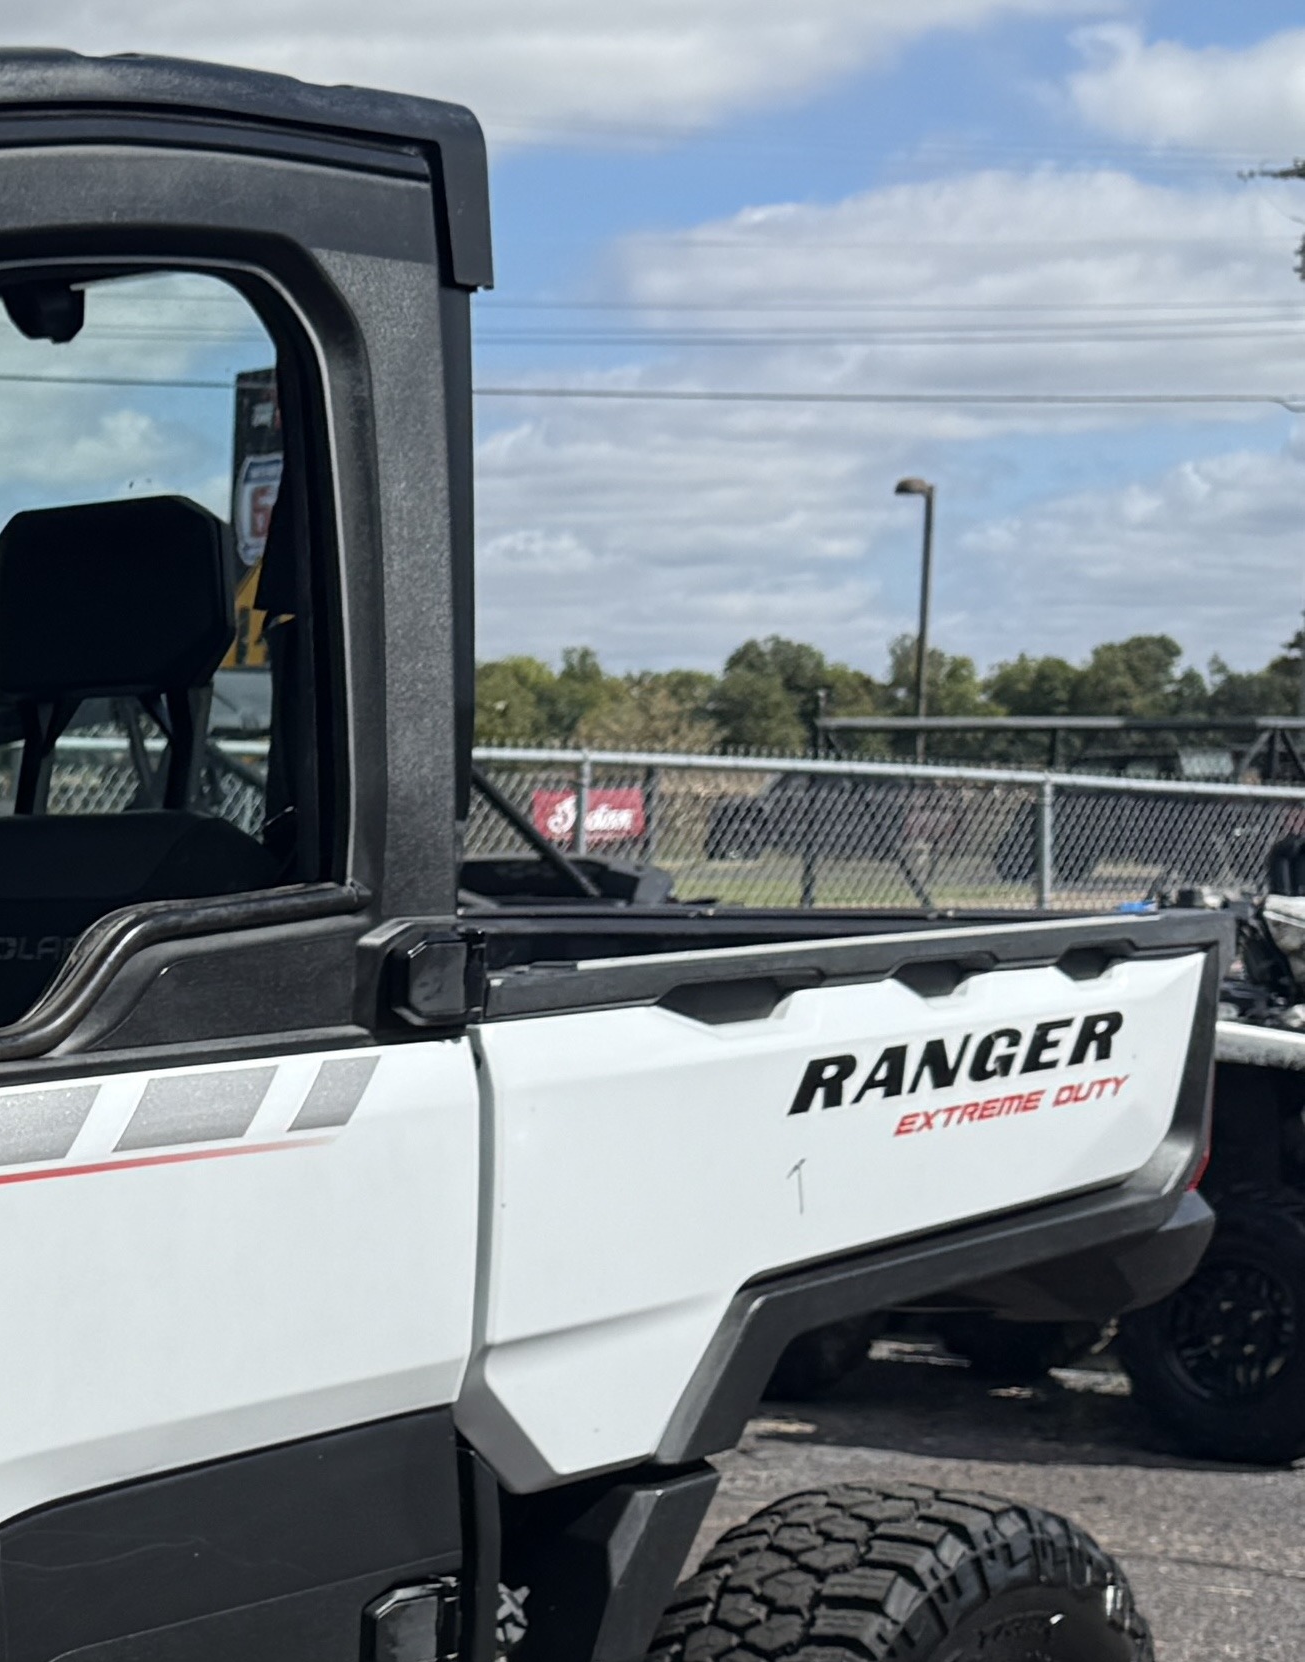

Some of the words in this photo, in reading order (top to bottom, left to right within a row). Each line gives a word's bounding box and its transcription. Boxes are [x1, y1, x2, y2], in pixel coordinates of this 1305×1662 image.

[787, 1011, 1123, 1116] RANGER
[894, 1089, 1046, 1137] EXTREME
[1052, 1074, 1129, 1107] DUTY
